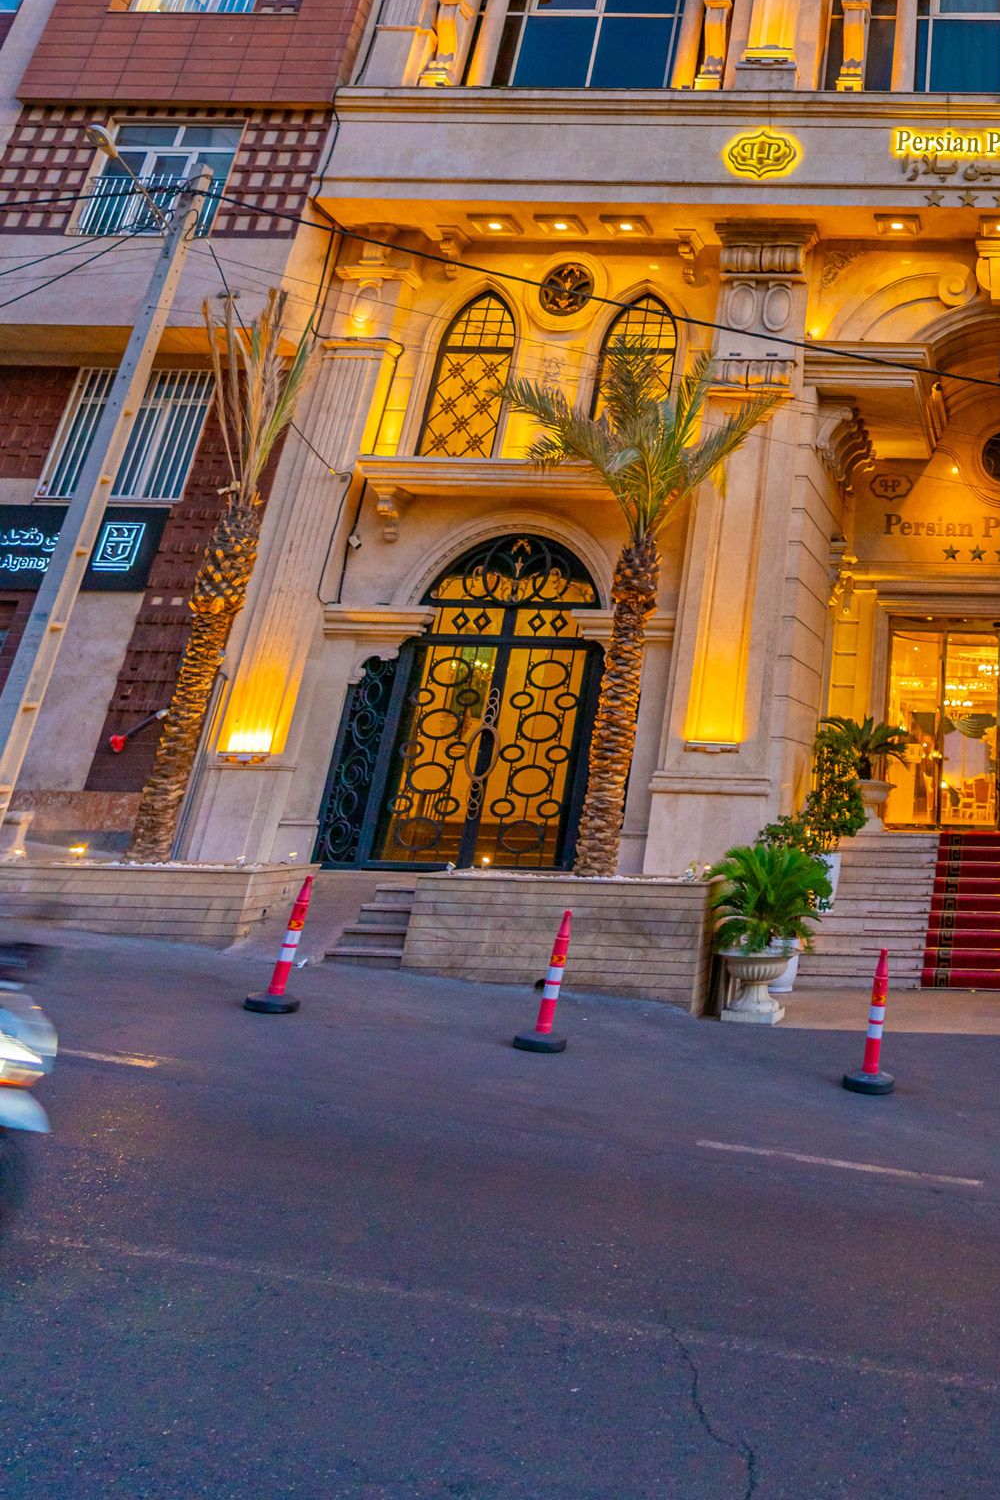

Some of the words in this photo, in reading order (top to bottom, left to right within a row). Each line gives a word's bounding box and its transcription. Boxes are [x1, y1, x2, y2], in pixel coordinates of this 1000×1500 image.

[896, 130, 979, 152] Persian
[900, 154, 959, 183] پلازا
[883, 513, 973, 538] Persian
[0, 554, 50, 572] Agency
